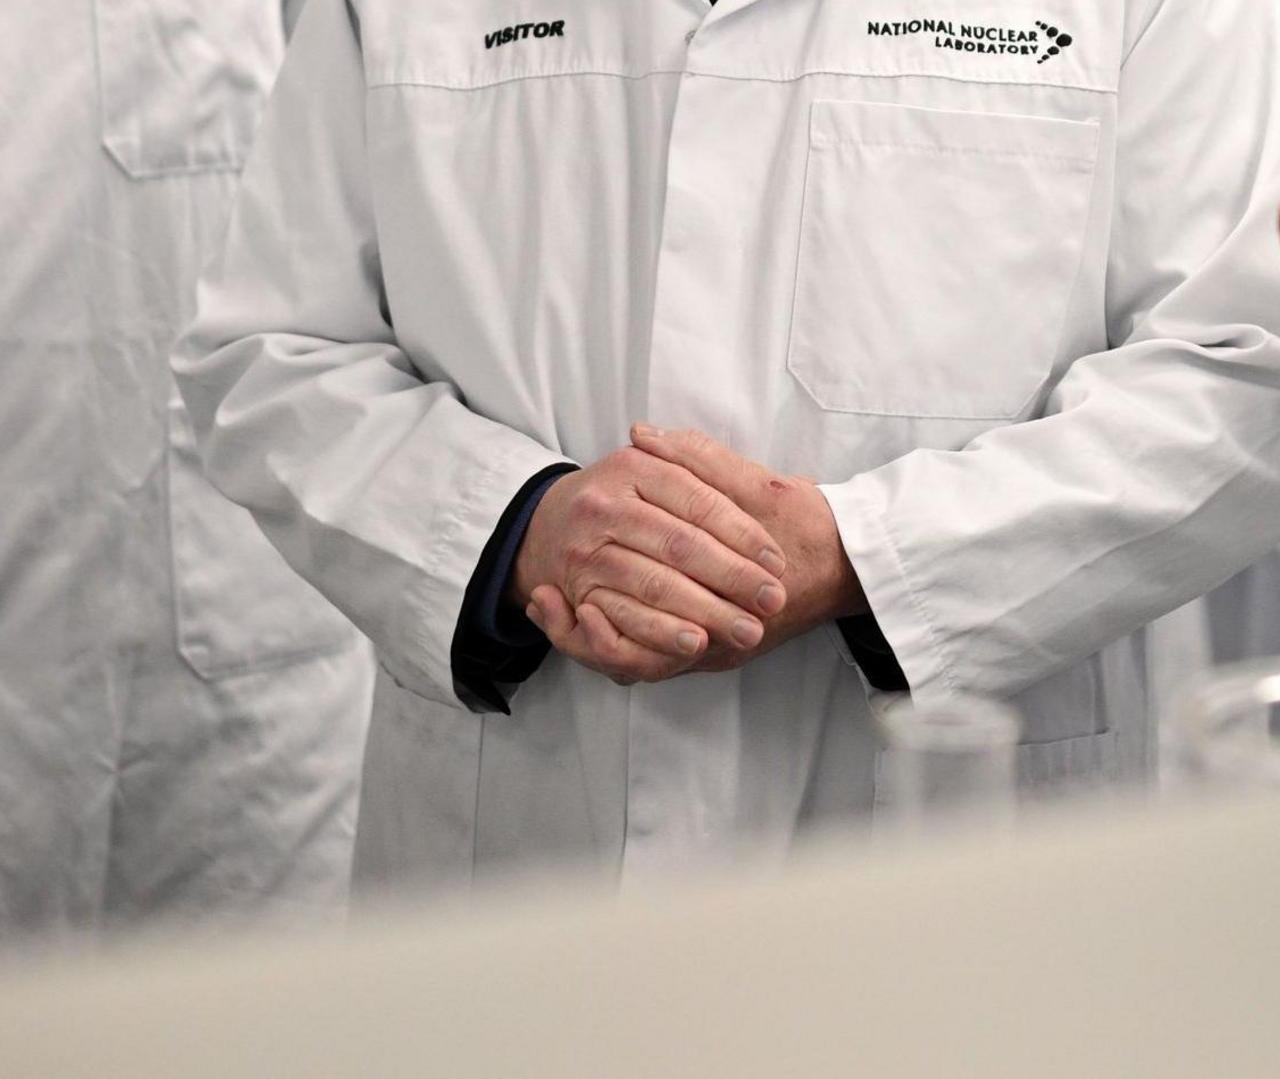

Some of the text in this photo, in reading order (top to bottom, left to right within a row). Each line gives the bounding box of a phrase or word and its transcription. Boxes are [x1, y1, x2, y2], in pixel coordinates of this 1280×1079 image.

[484, 19, 565, 50] VISITOR
[867, 19, 1038, 43] NATIONAL NUCLEAR
[934, 36, 1039, 55] LABORATORY
